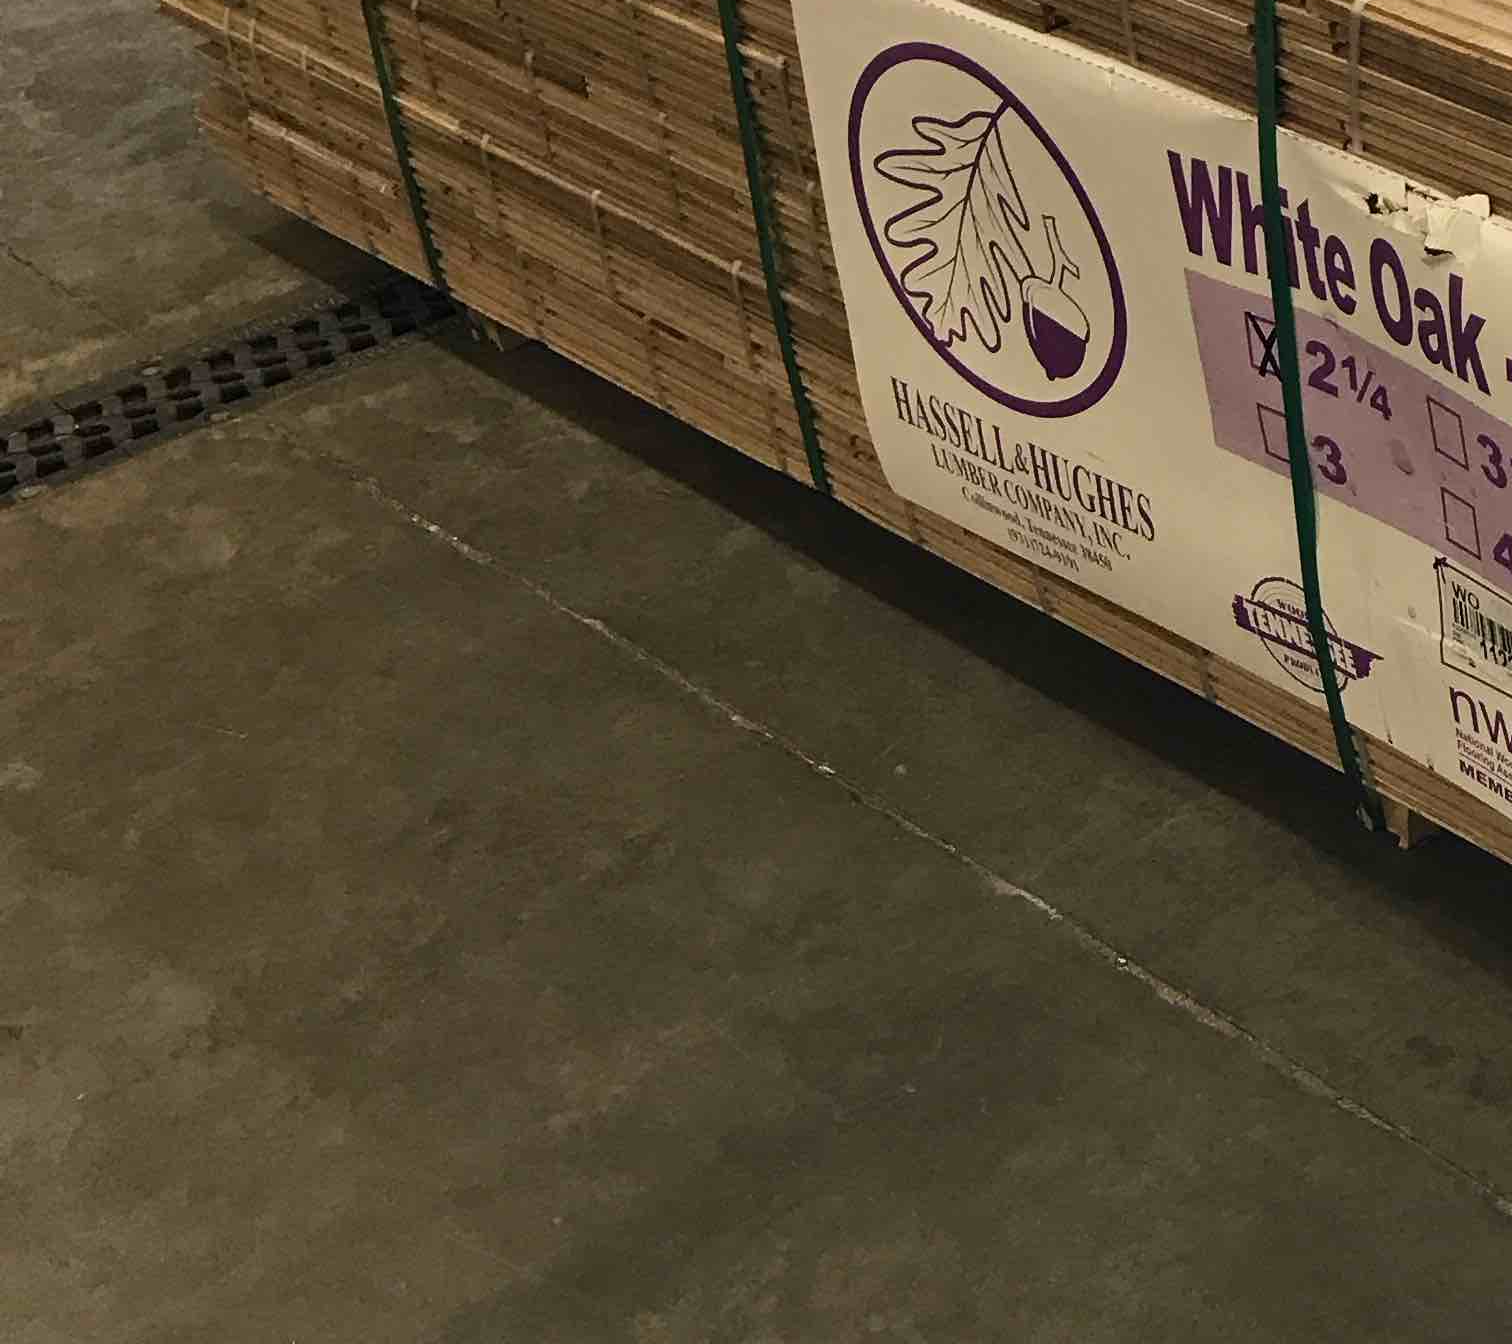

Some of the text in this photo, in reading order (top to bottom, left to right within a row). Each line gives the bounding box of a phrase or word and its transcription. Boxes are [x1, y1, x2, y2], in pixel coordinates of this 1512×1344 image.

[1369, 237, 1492, 397] Oak
[890, 375, 1156, 542] HASSELL & HUGHES
[930, 443, 1131, 561] LUMBER COMPANY, INC.
[1311, 435, 1348, 486] 3
[1244, 602, 1358, 676] TENNEEE
[1451, 581, 1481, 611] WO
